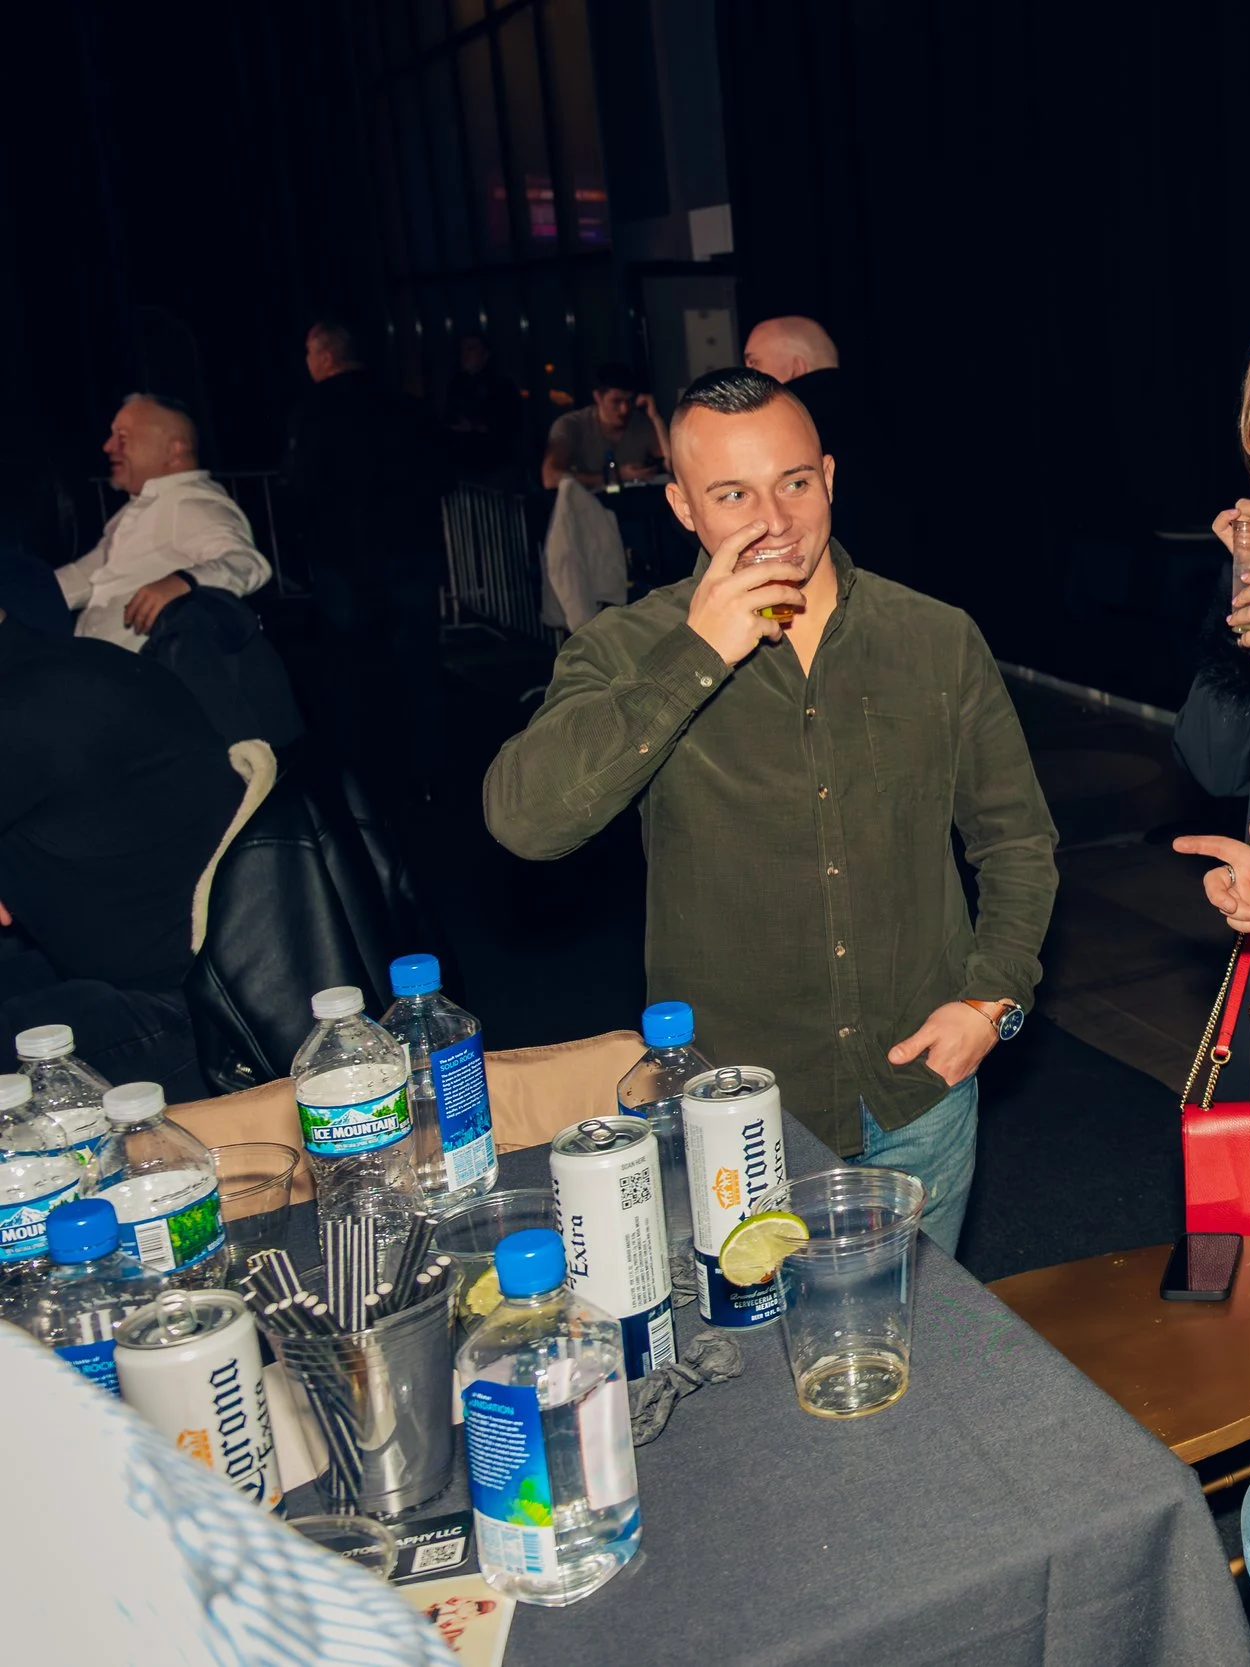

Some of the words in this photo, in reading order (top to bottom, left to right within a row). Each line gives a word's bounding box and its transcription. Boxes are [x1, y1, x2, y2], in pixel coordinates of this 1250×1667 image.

[440, 1059, 459, 1072] SOLID
[459, 1051, 475, 1064] ROCK
[314, 1128, 331, 1140] ICE
[332, 1117, 398, 1140] MOUNTAIN
[569, 1214, 590, 1278] Extra
[733, 1295, 774, 1309] CERVECERIA
[468, 1399, 515, 1416] UNDATION
[254, 1377, 274, 1462] Extra
[436, 1526, 463, 1539] LLC
